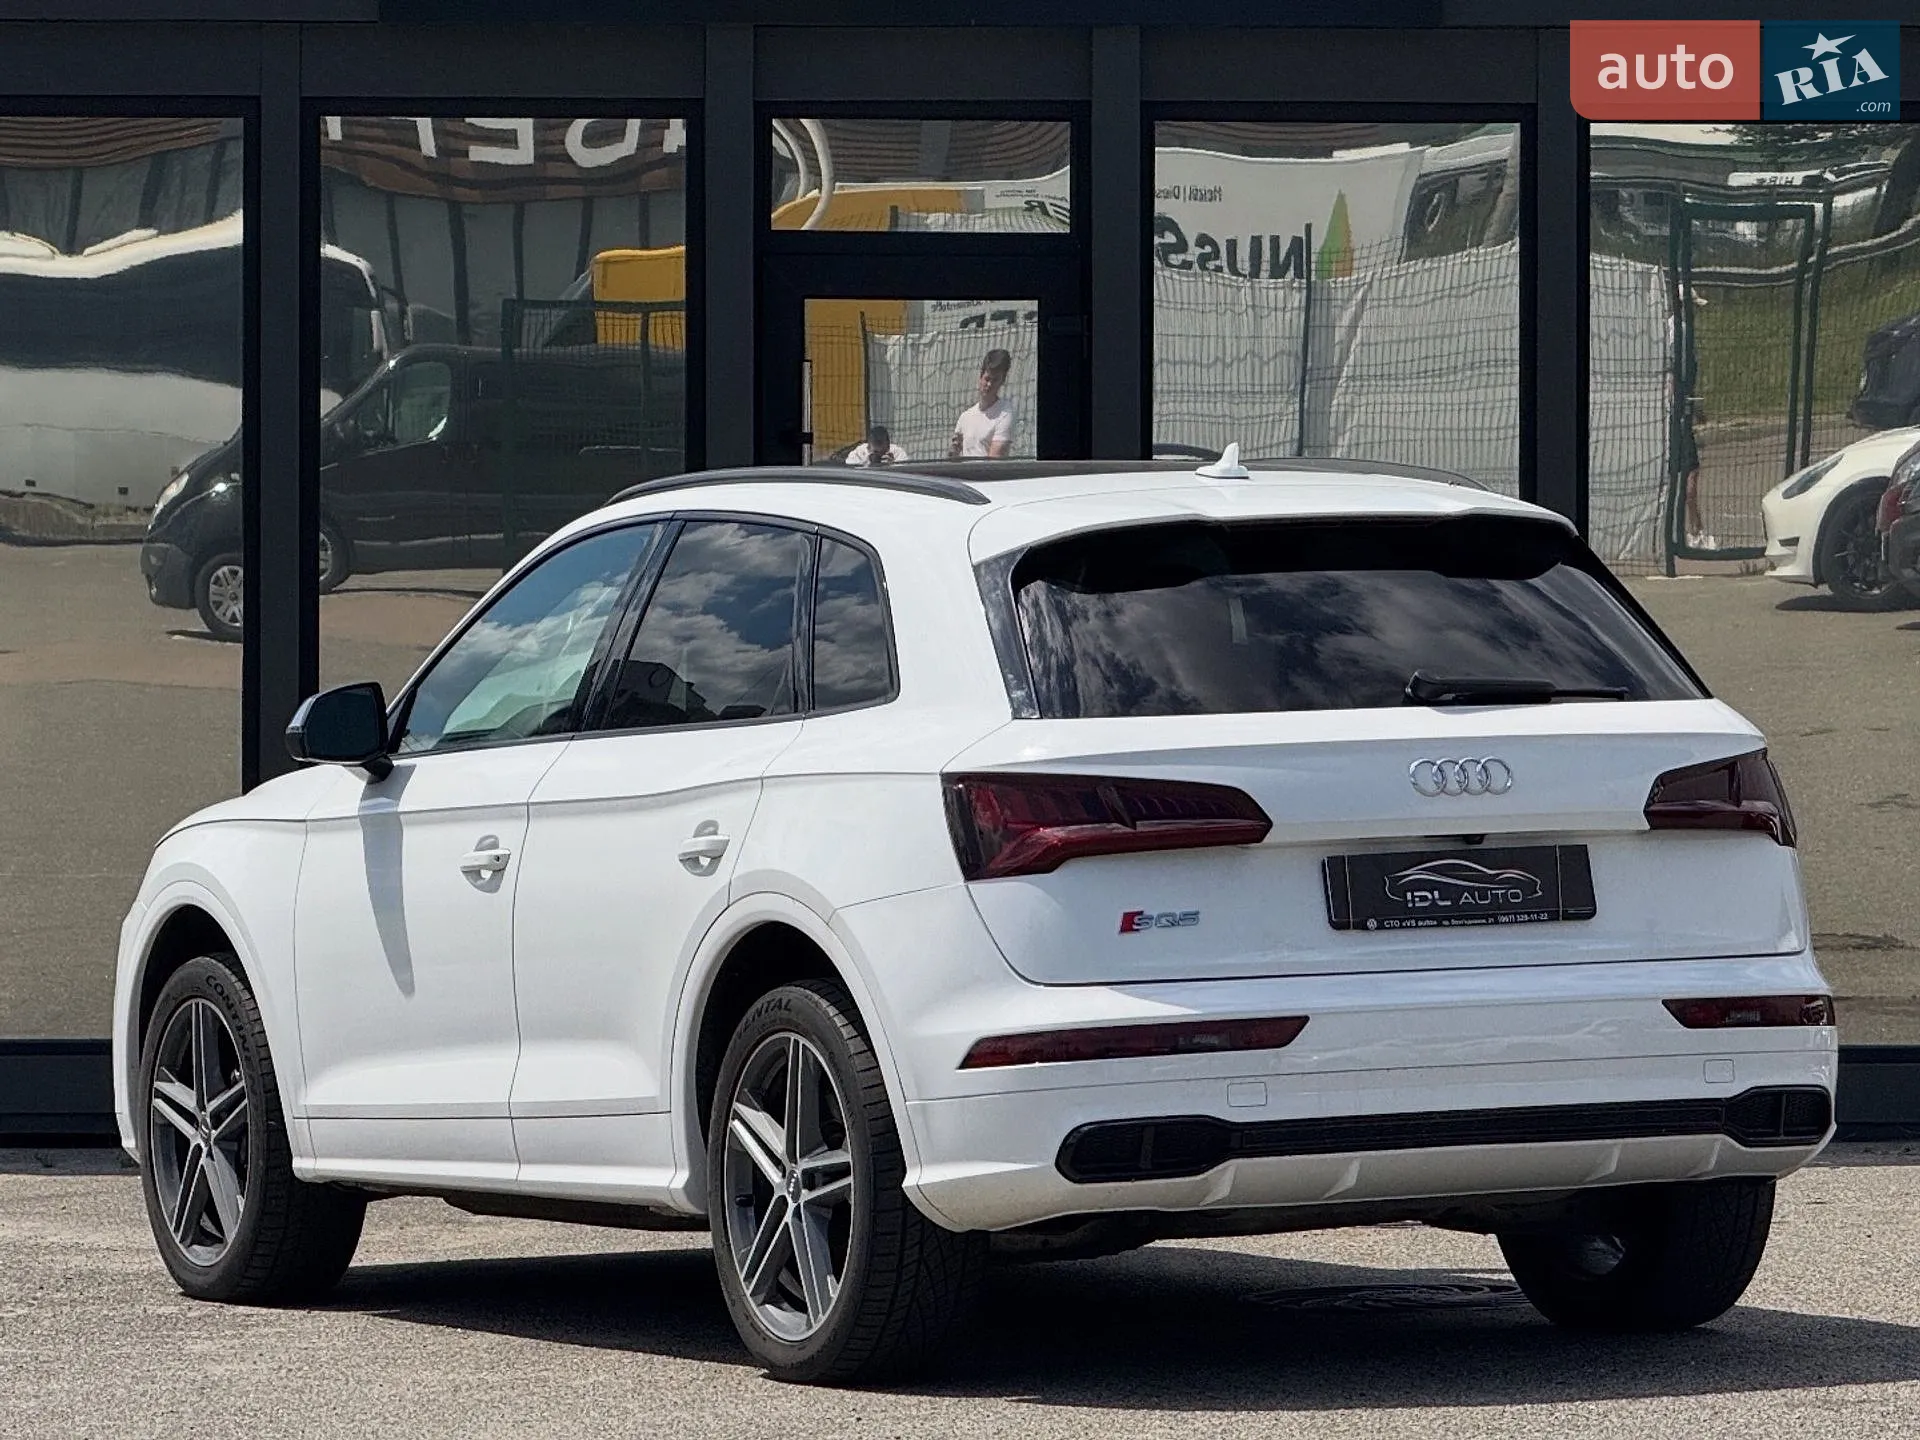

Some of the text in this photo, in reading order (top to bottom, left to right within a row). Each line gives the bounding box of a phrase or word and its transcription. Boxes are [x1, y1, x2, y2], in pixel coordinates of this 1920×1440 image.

[1406, 889, 1523, 907] IDL AUTO
[1129, 909, 1201, 932] SQ5
